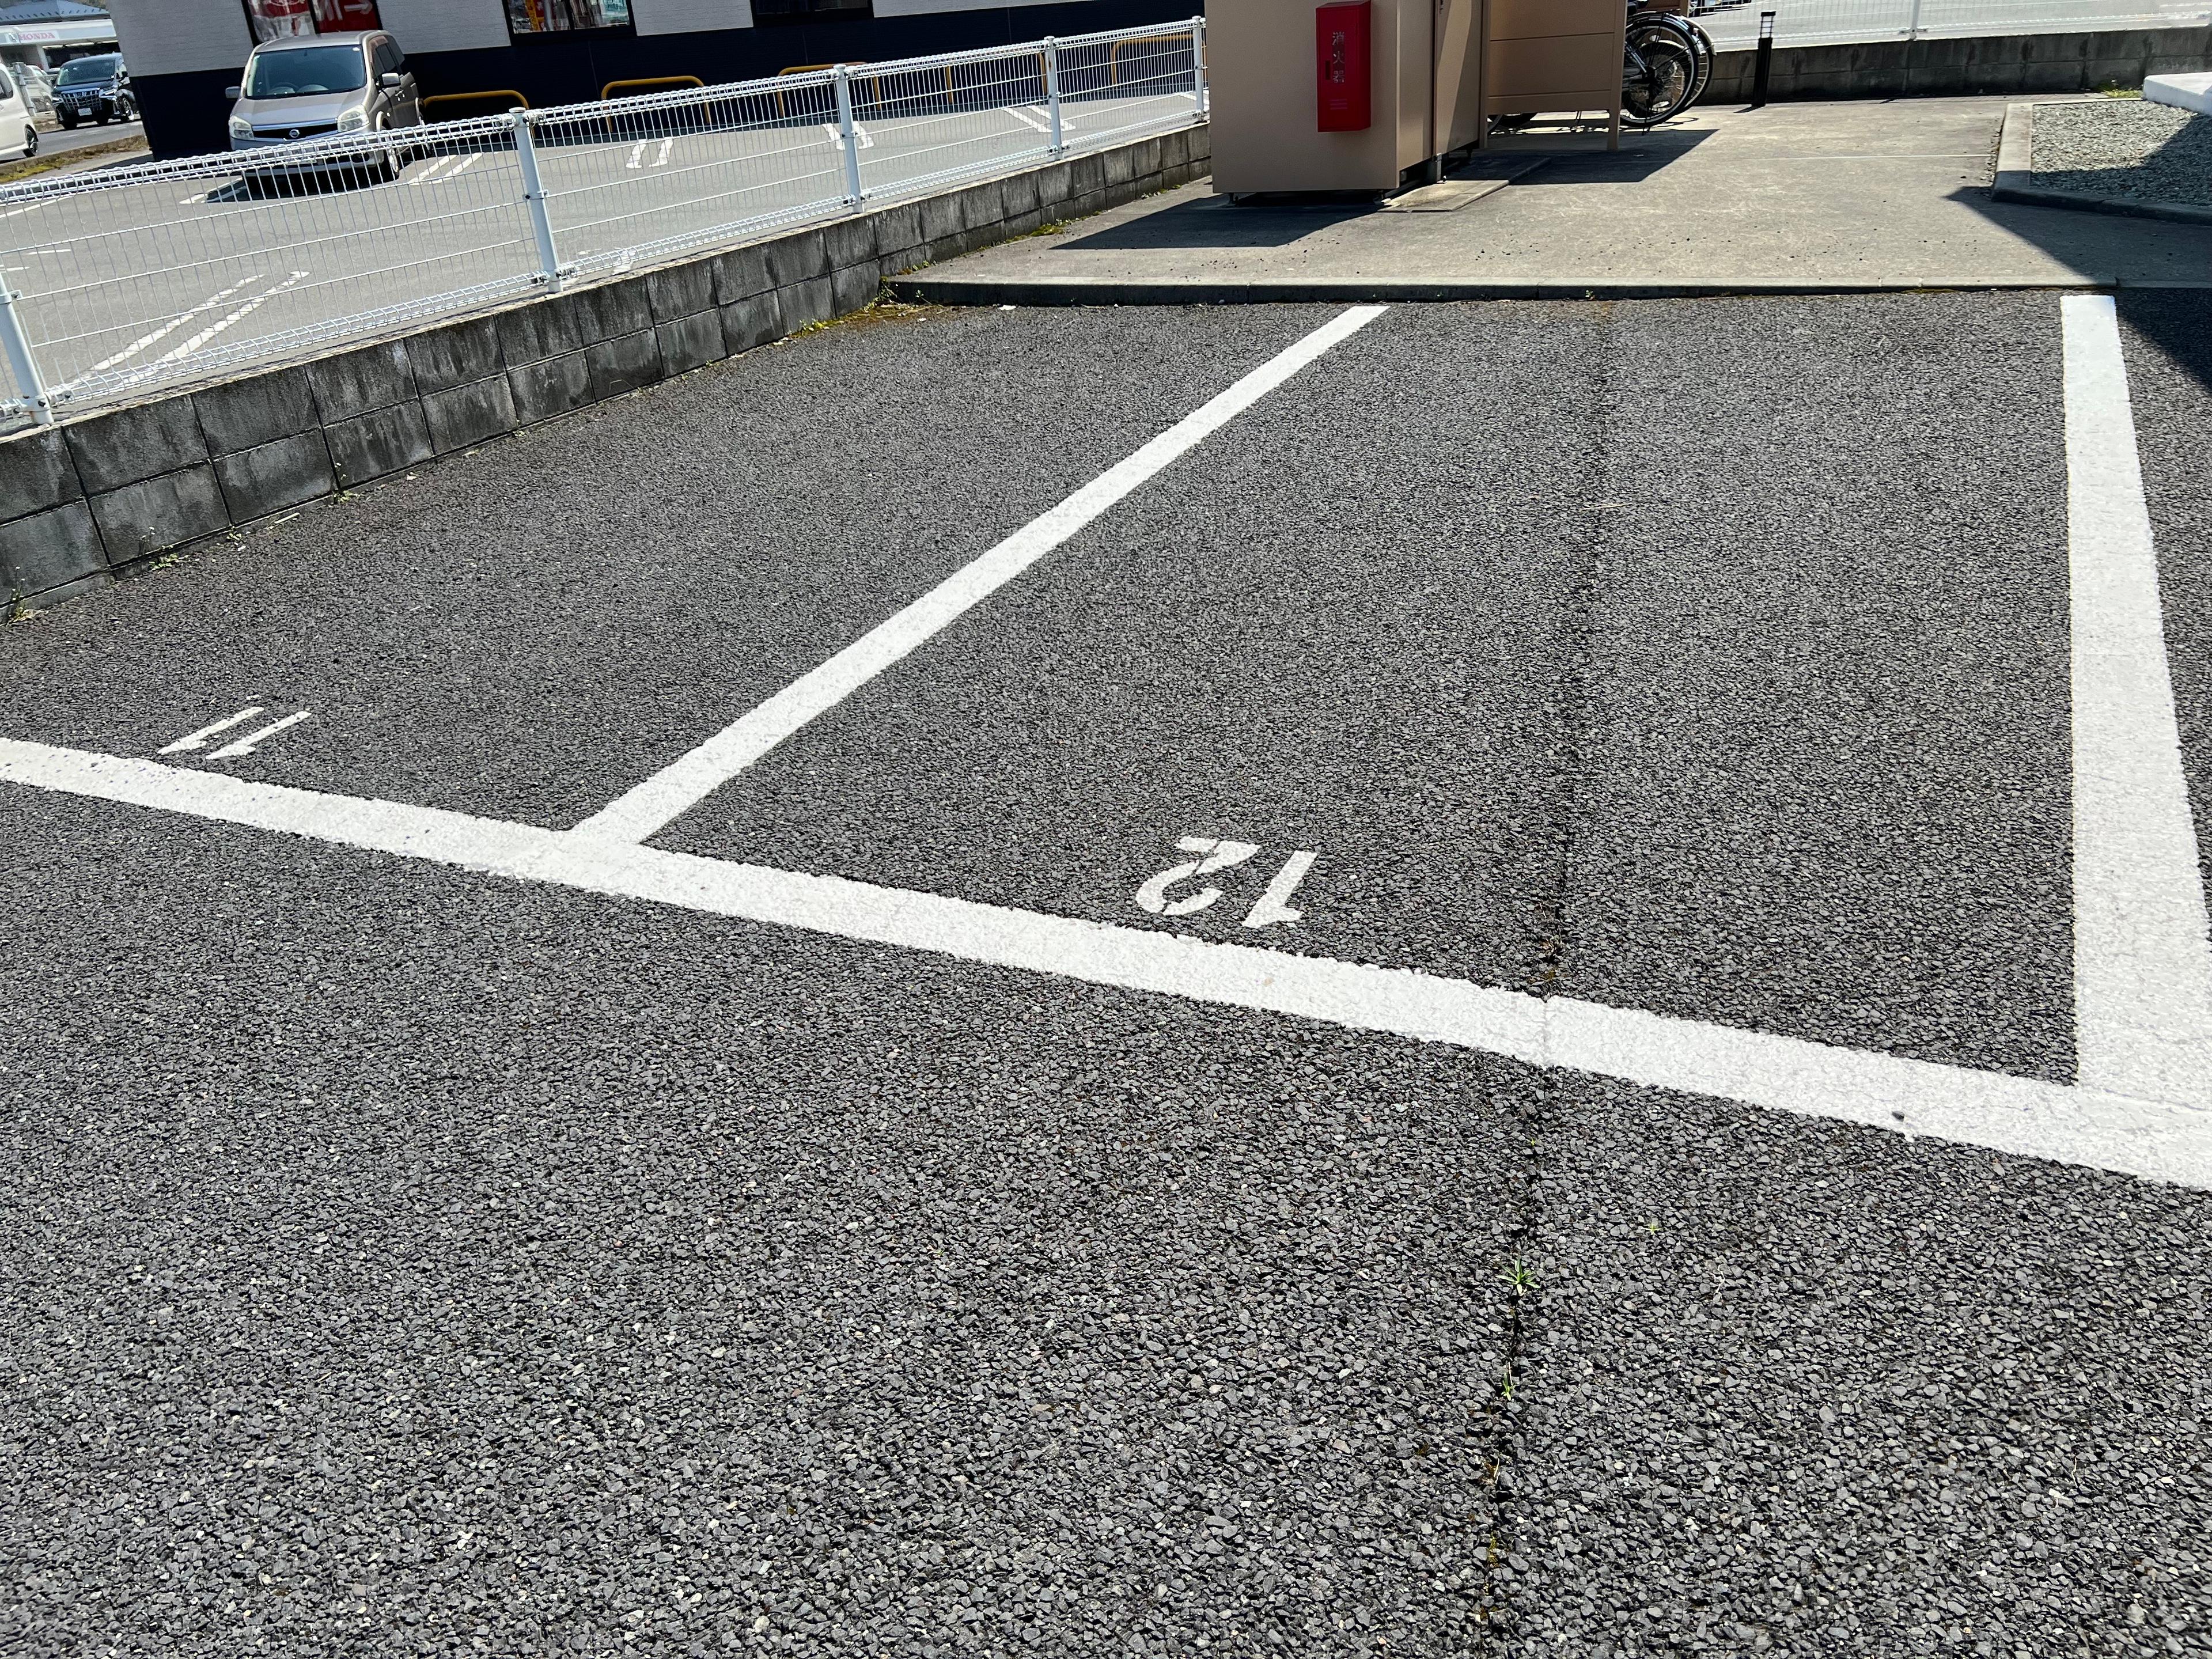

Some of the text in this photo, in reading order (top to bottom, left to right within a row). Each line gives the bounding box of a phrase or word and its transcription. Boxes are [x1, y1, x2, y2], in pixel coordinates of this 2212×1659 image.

[18, 32, 56, 41] HONDA
[1332, 31, 1345, 83] 消火器
[157, 706, 312, 760] 11
[1135, 836, 1319, 929] 12
